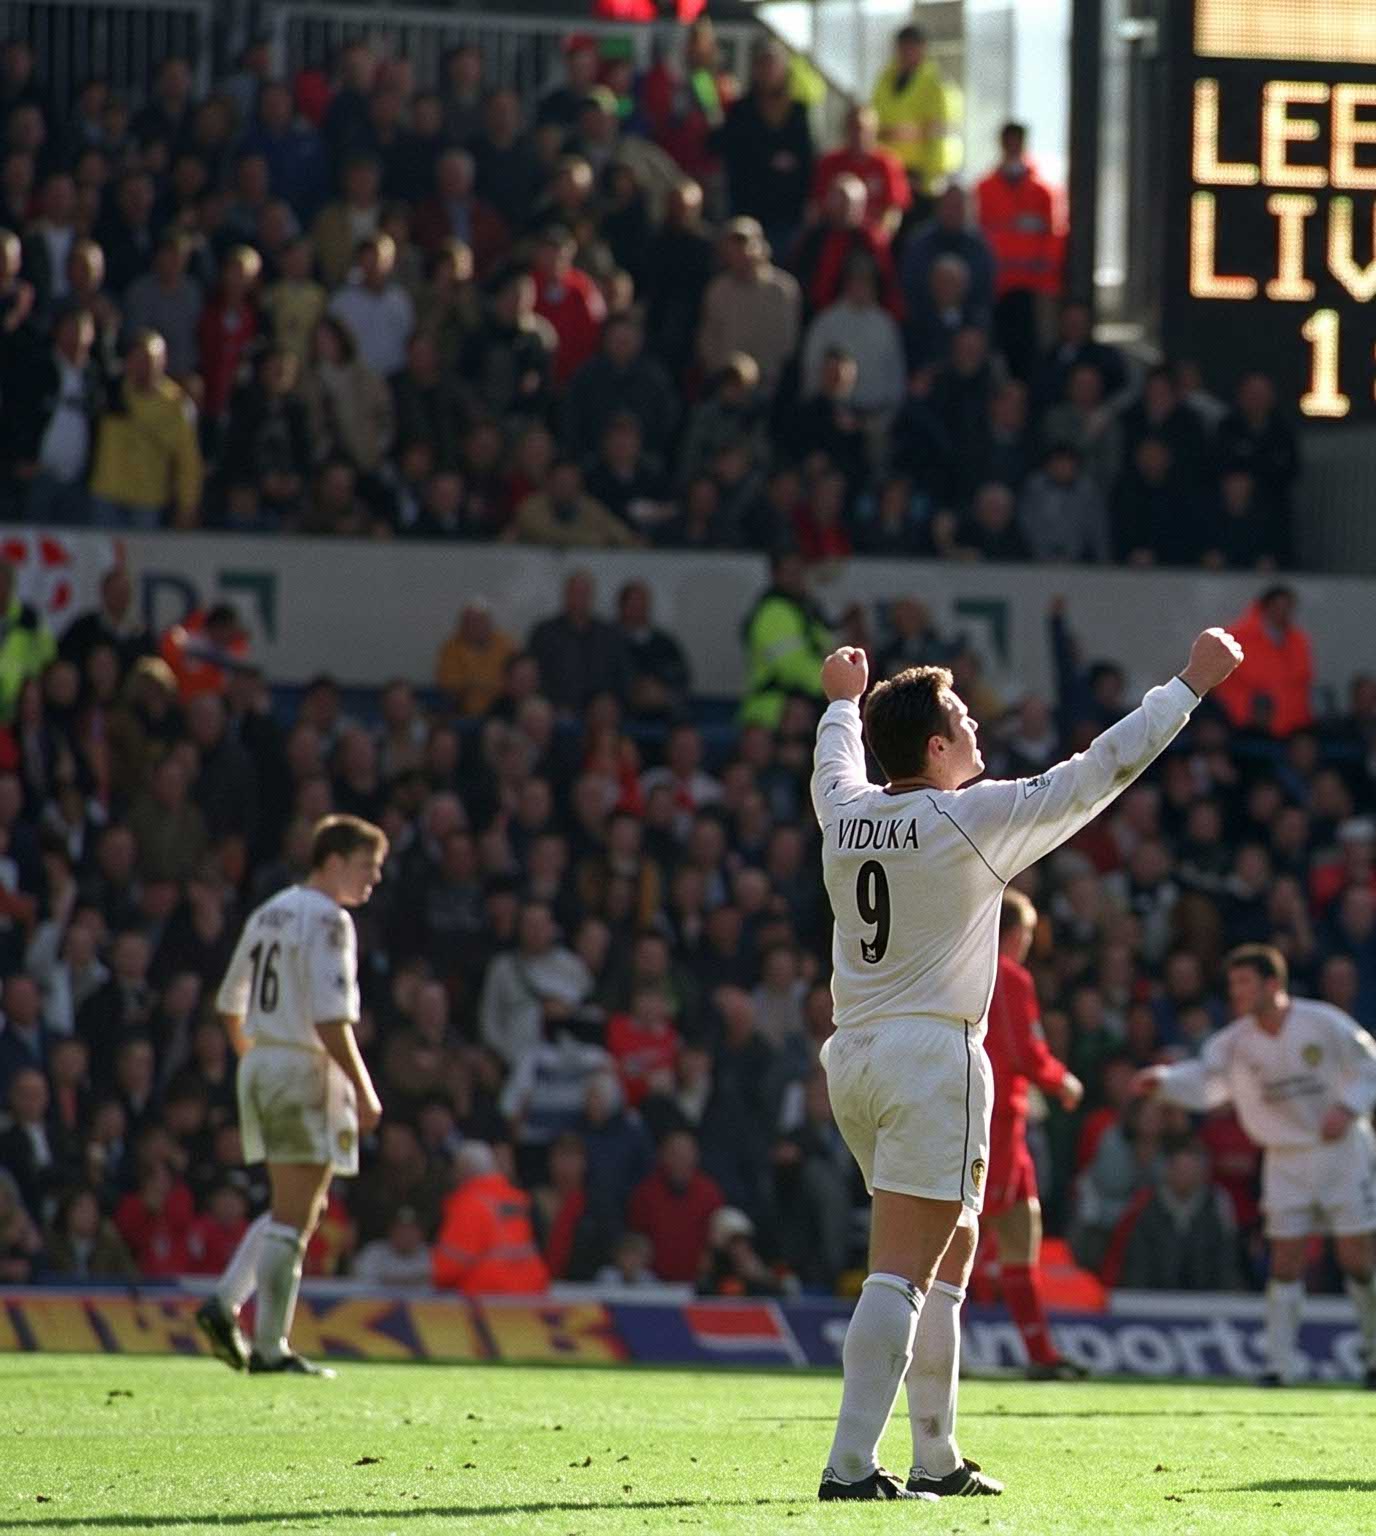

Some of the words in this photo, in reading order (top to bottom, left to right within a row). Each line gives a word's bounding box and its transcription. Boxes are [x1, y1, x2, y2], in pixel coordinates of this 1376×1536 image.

[838, 818, 919, 850] VIDUKA
[856, 860, 891, 964] 9
[249, 939, 282, 1014] 16
